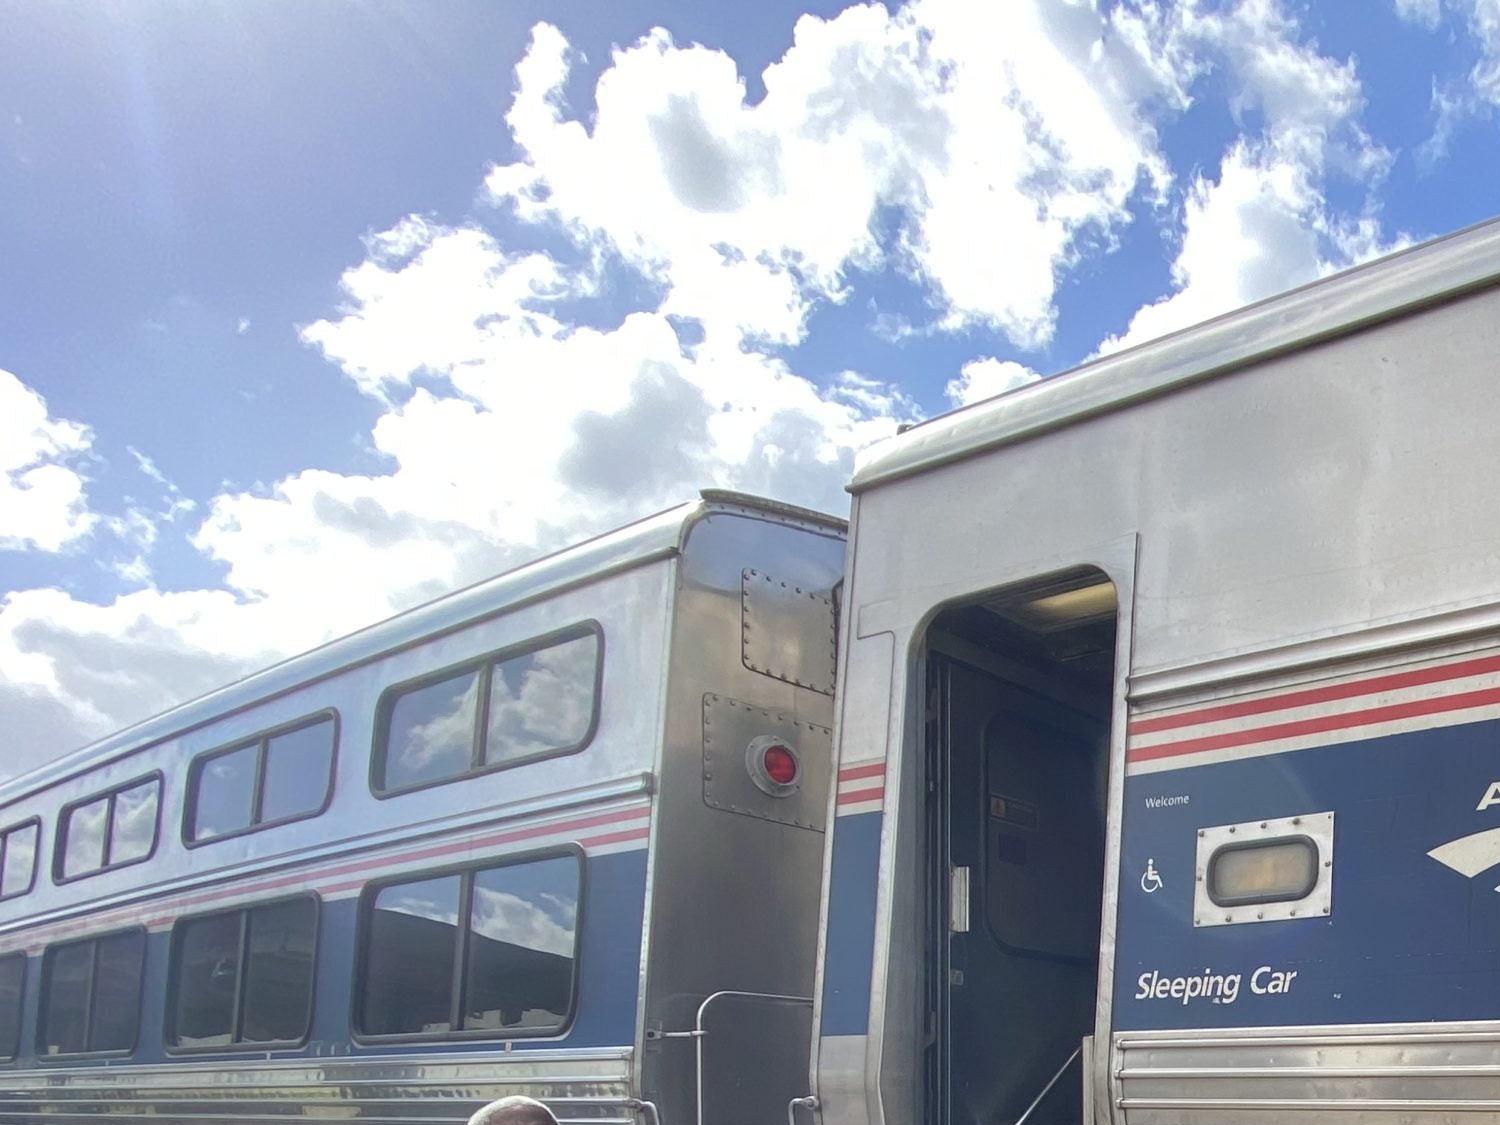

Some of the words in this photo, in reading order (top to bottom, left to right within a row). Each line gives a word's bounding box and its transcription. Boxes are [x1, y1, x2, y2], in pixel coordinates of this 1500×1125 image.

[1145, 794, 1190, 809] Welcome
[1135, 968, 1242, 1005] Sleeping
[1250, 966, 1298, 995] Car
